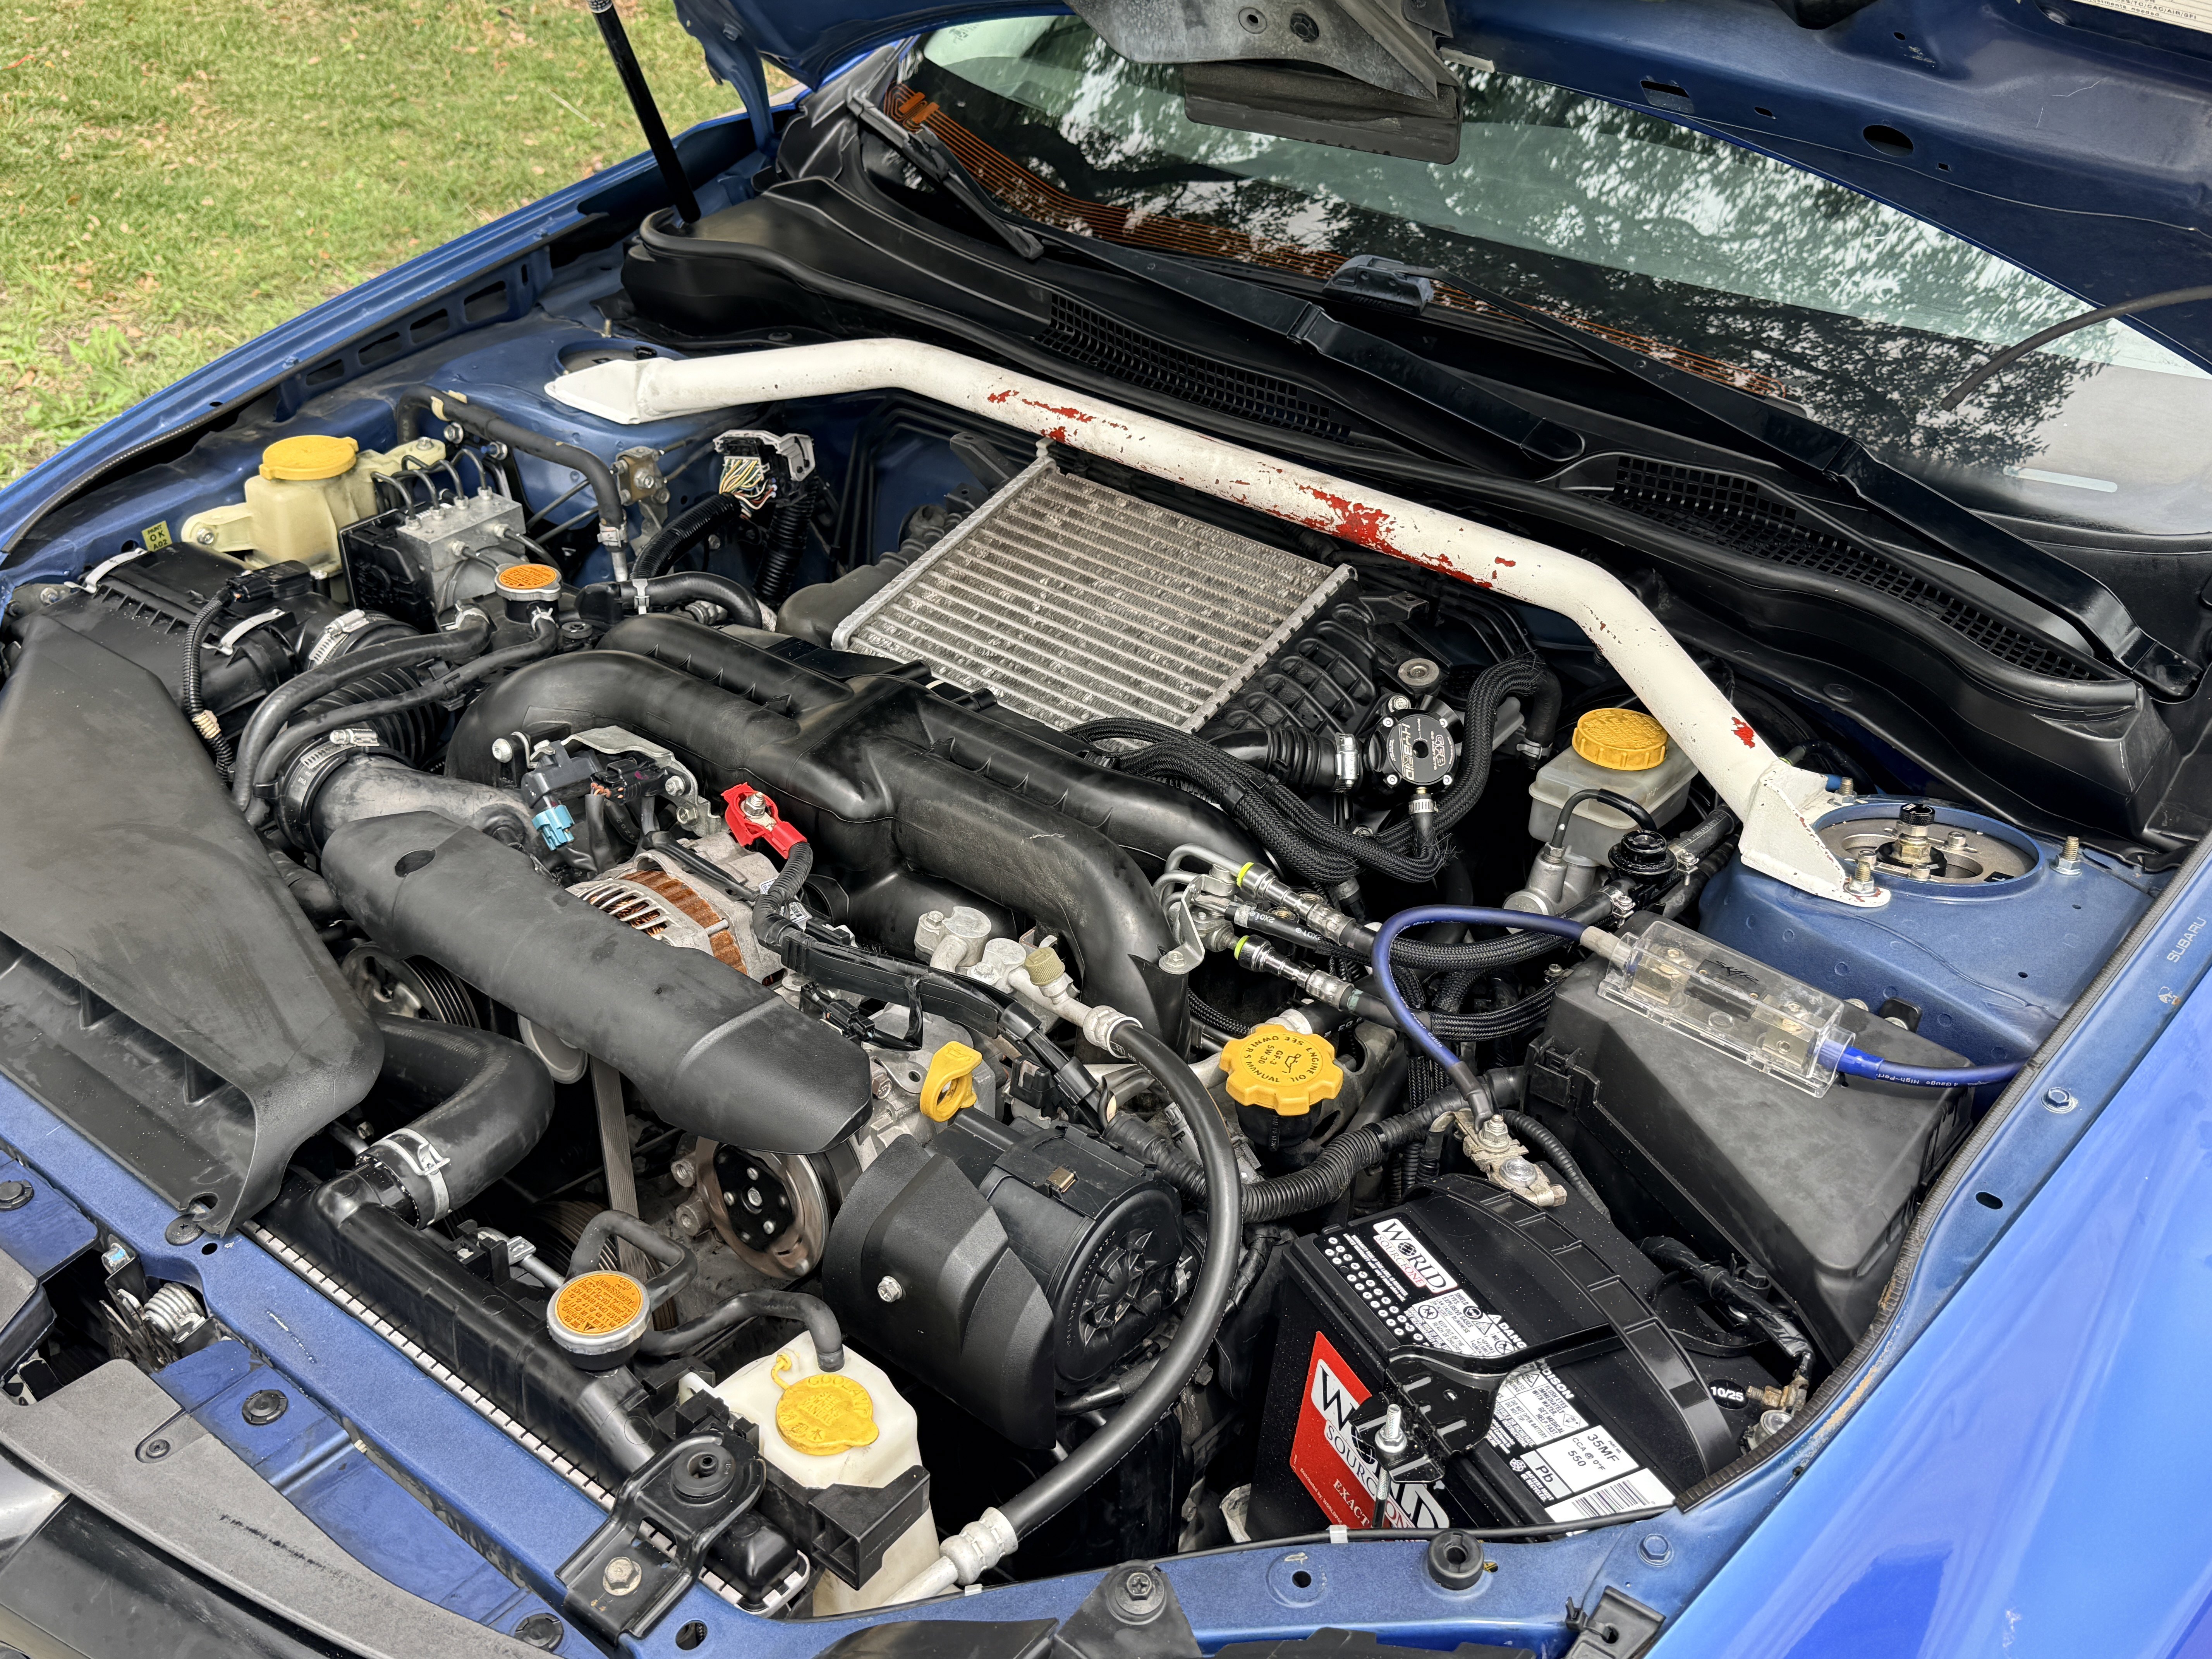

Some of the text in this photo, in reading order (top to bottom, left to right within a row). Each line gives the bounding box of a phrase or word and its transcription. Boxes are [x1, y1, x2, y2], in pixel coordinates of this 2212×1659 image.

[154, 539, 167, 550] A02
[2167, 917, 2207, 963] SUBARU
[1285, 1036, 1304, 1046] SEE
[1245, 1061, 1280, 1083] MANUAL
[1290, 1047, 1319, 1082] ENGINE OIL
[1877, 1073, 1920, 1085] High-Perf
[1381, 1221, 1446, 1288] WORLD
[571, 1286, 623, 1324] NEVER OPEN WHEN HOT
[1448, 1294, 1459, 1305] EYES.
[1454, 1292, 1469, 1305] SHIELD
[562, 1306, 586, 1324] WARNING
[1442, 1297, 1474, 1328] EXPLOSIVE GASES
[1443, 1305, 1453, 1316] CAUSE
[1451, 1316, 1470, 1333] BLINDNESS
[1498, 1322, 1527, 1348] DANG
[1510, 1381, 1521, 1393] URNS
[1542, 1368, 1574, 1399] OISON
[1711, 1386, 1744, 1401] 10/25
[808, 1375, 869, 1416] COOLANT
[820, 1391, 841, 1404] SEE
[1532, 1390, 1558, 1416] WITH WATER.
[1538, 1388, 1566, 1414] IMMEDIATELY
[1544, 1385, 1568, 1408] FLUSH EYES
[1522, 1413, 1533, 1424] OPEN
[1531, 1423, 1548, 1439] BATTERY.
[1535, 1414, 1558, 1436] HELP FAST.
[1545, 1415, 1565, 1434] MEDICAL
[1572, 1437, 1586, 1452] CCA
[1587, 1434, 1620, 1462] 35MF
[1608, 1440, 1616, 1449] PART
[1568, 1450, 1587, 1467] 550
[1300, 1468, 1318, 1493] Distributed
[1535, 1465, 1554, 1482] Pb
[1525, 1470, 1554, 1501] BATTERY MUST
[1526, 1479, 1546, 1502] RECYCLED.
[1333, 1479, 1370, 1527] EXACT
